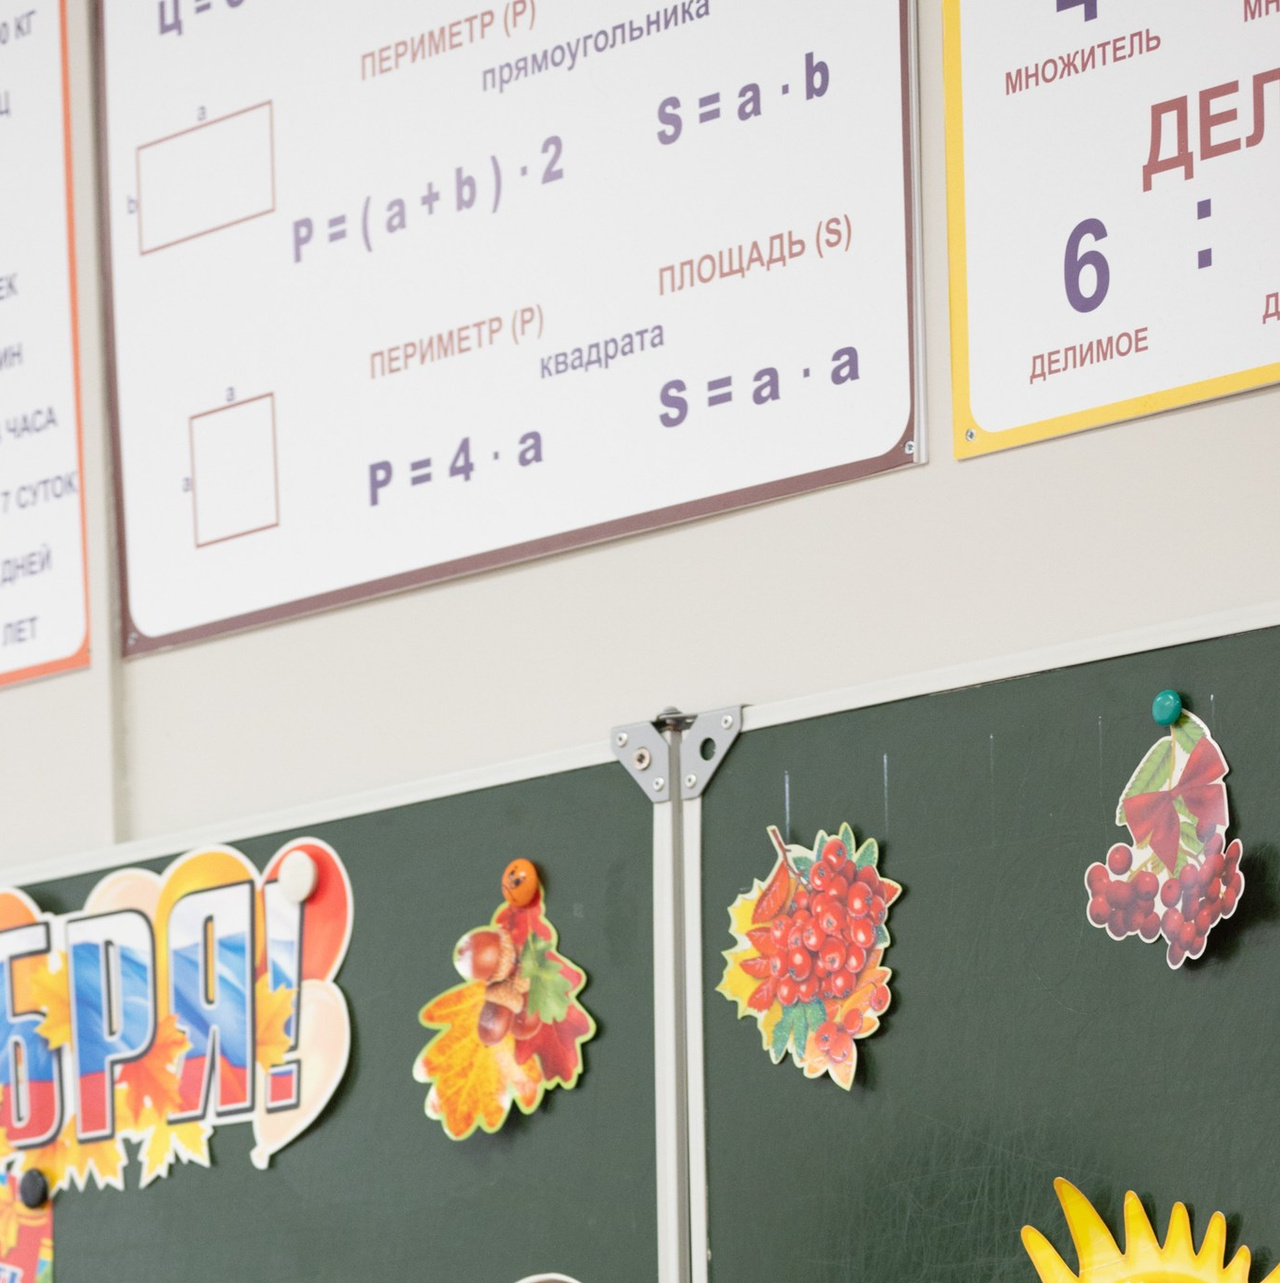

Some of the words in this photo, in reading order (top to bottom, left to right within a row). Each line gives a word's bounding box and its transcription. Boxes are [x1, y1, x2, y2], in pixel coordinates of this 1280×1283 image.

[13, 9, 36, 38] КГ
[158, 0, 183, 36] Ц
[359, 10, 496, 81] ПЕРИМЕТР
[481, 0, 711, 94] прямоугольника
[1004, 28, 1162, 96] МНОЖИТЕЛЬ
[659, 230, 806, 296] ПЛОЩАДЬ
[815, 214, 852, 259] (S)
[1063, 217, 1111, 314] 6
[370, 316, 503, 379] ПЕРИМЕТР
[540, 323, 665, 380] квадрата
[1029, 326, 1149, 385] ДЕЛИМОЕ
[5, 406, 57, 438] ЧАСА
[1, 490, 10, 512] 7
[17, 468, 77, 509] СУТОК
[0, 543, 51, 586] ДНЕЙ
[2, 615, 38, 646] ЛЕТ
